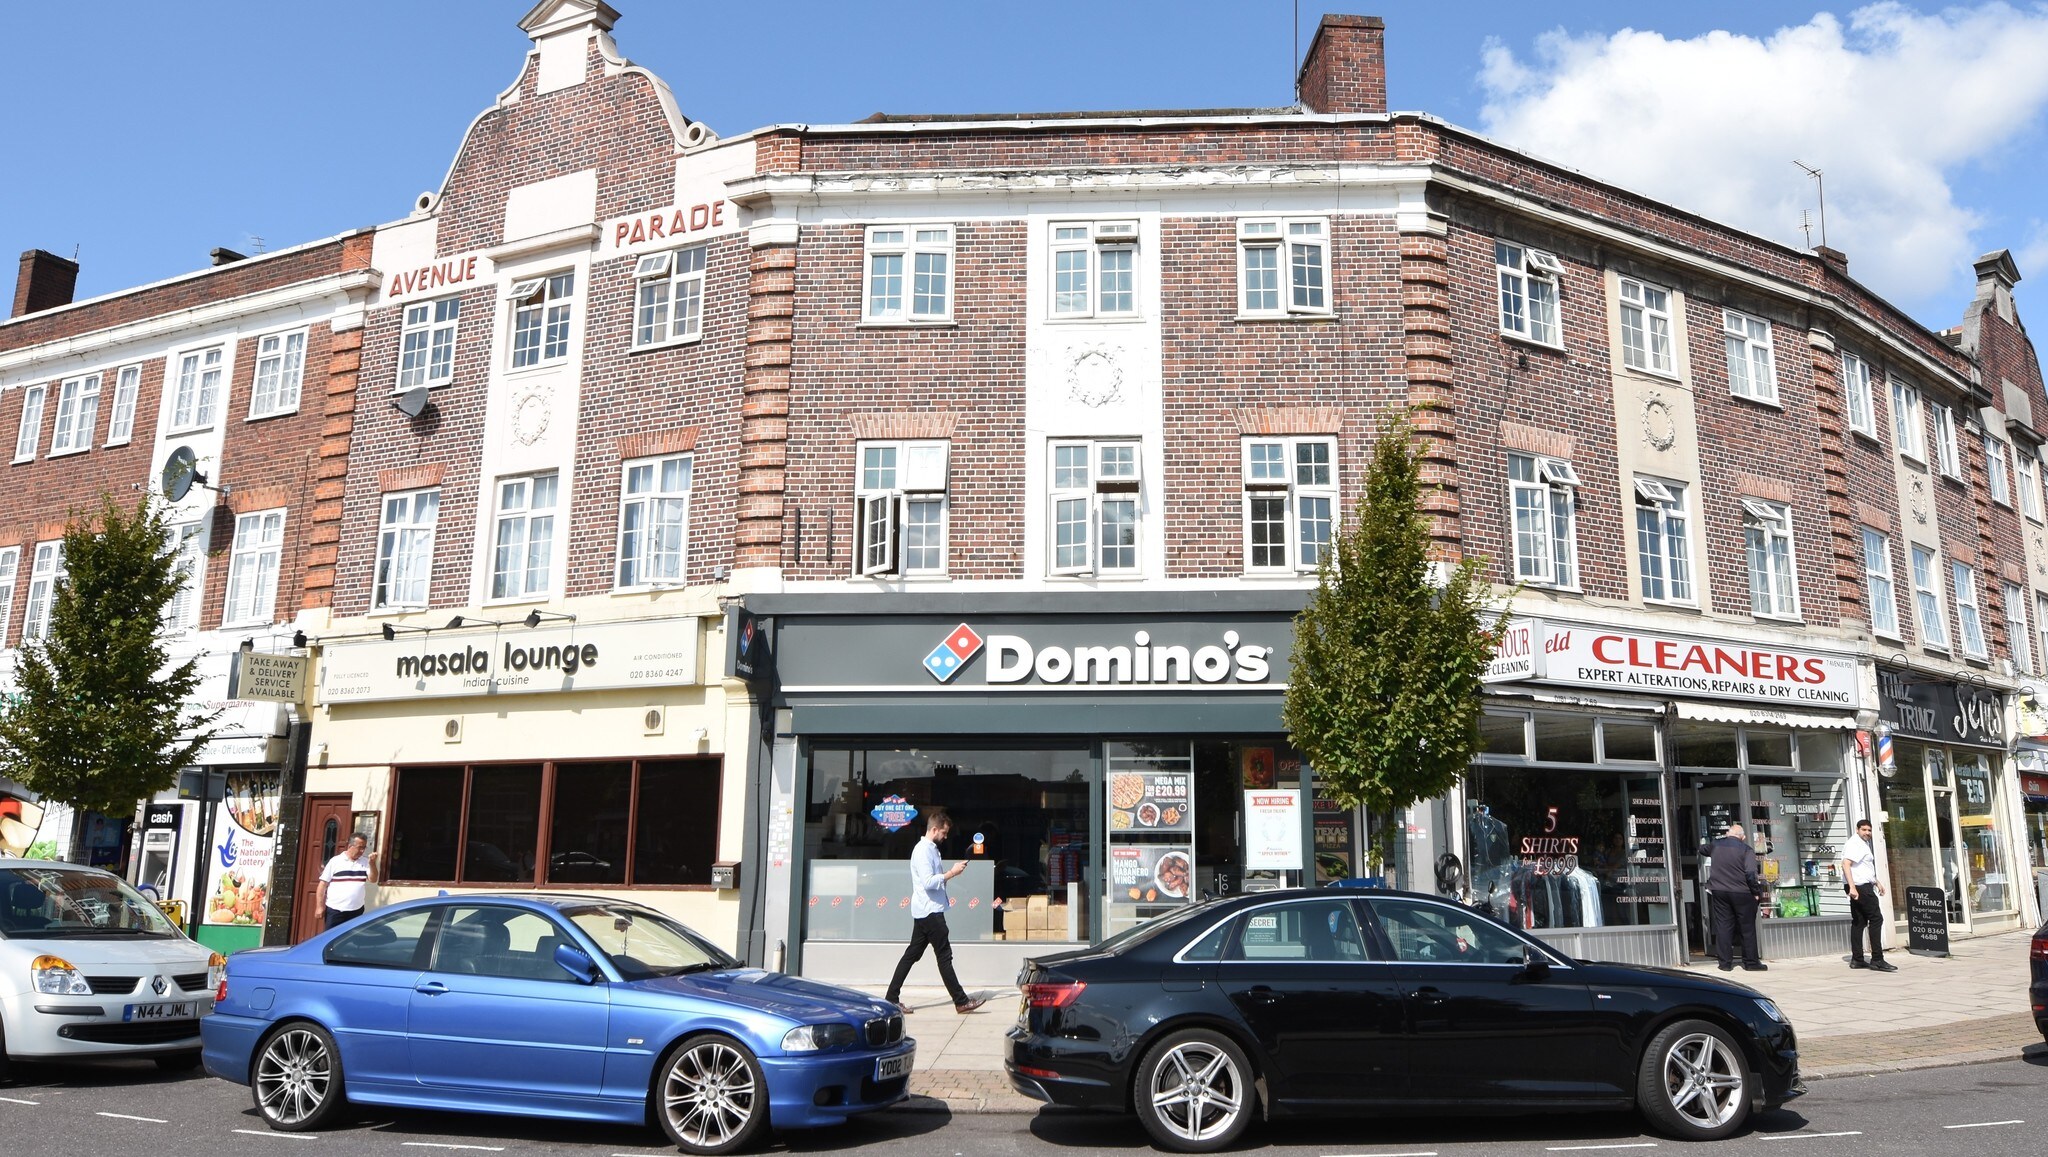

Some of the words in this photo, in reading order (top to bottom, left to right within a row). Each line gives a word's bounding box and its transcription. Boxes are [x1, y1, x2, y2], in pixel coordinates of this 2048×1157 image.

[388, 255, 478, 299] AVENUE
[614, 199, 725, 248] PARADE
[1496, 628, 1530, 659] HOUR
[329, 650, 334, 658] 5
[633, 653, 643, 662] AIR
[643, 652, 683, 662] CONDITIONED
[985, 630, 1271, 684] Domino's
[1545, 630, 1571, 655] eld
[1591, 635, 1826, 685] CLEANERS
[249, 657, 271, 667] TAKE
[272, 659, 300, 670] AWAY
[396, 645, 489, 679] masala
[503, 641, 599, 676] lounge
[1829, 660, 1844, 668] AVENUE
[249, 667, 256, 676] &
[258, 668, 298, 679] DELIVERY
[1492, 659, 1530, 676] CLEANING
[629, 670, 644, 679] 020
[645, 669, 664, 679] 8360
[665, 668, 684, 678] 4247
[254, 677, 291, 688] SERVICE
[462, 676, 492, 688] Indian
[495, 674, 530, 688] cuisine
[1578, 667, 1623, 683] EXPERT
[1758, 685, 1767, 696] &
[1769, 685, 1791, 698] DRY
[1797, 687, 1849, 703] CLEANING
[248, 687, 296, 699] AVAILABLE
[327, 687, 339, 696] 020
[340, 686, 355, 696] 8360
[356, 685, 371, 695] 2073
[206, 699, 256, 712] Supermarket
[1896, 702, 1938, 734] TRIMZ
[222, 744, 232, 755] Off
[233, 744, 257, 755] Licence
[1279, 760, 1301, 772] OPE
[1154, 776, 1174, 786] MEGA
[1173, 776, 1187, 786] MIX
[1154, 785, 1187, 797] £20.99
[1966, 778, 1986, 804] £59
[1255, 796, 1269, 806] NOW
[1270, 796, 1290, 806] HIRING
[1632, 798, 1644, 806] SHOE
[1785, 804, 1797, 814] HOUR
[1797, 804, 1819, 814] CLEANING
[150, 810, 173, 824] cash
[883, 811, 906, 822] FREE
[1544, 808, 1558, 833] 5
[1314, 827, 1348, 837] TEXAS
[241, 838, 254, 847] The
[1520, 836, 1579, 854] SHIRTS
[239, 848, 271, 857] National
[238, 858, 266, 868] Lottery
[1112, 859, 1138, 868] MANGO
[1112, 867, 1149, 877] HABANERO
[1113, 876, 1137, 885] WINGS
[1909, 891, 1930, 900] TIMZ
[1916, 898, 1943, 908] TRIMZ
[1911, 905, 1943, 914] Experience
[1249, 918, 1276, 927] SECRET
[1927, 927, 1945, 935] 8360
[1920, 933, 1938, 941] 4688
[137, 1004, 163, 1019] N44
[166, 1003, 189, 1017] JML
[881, 1058, 902, 1077] YD02
